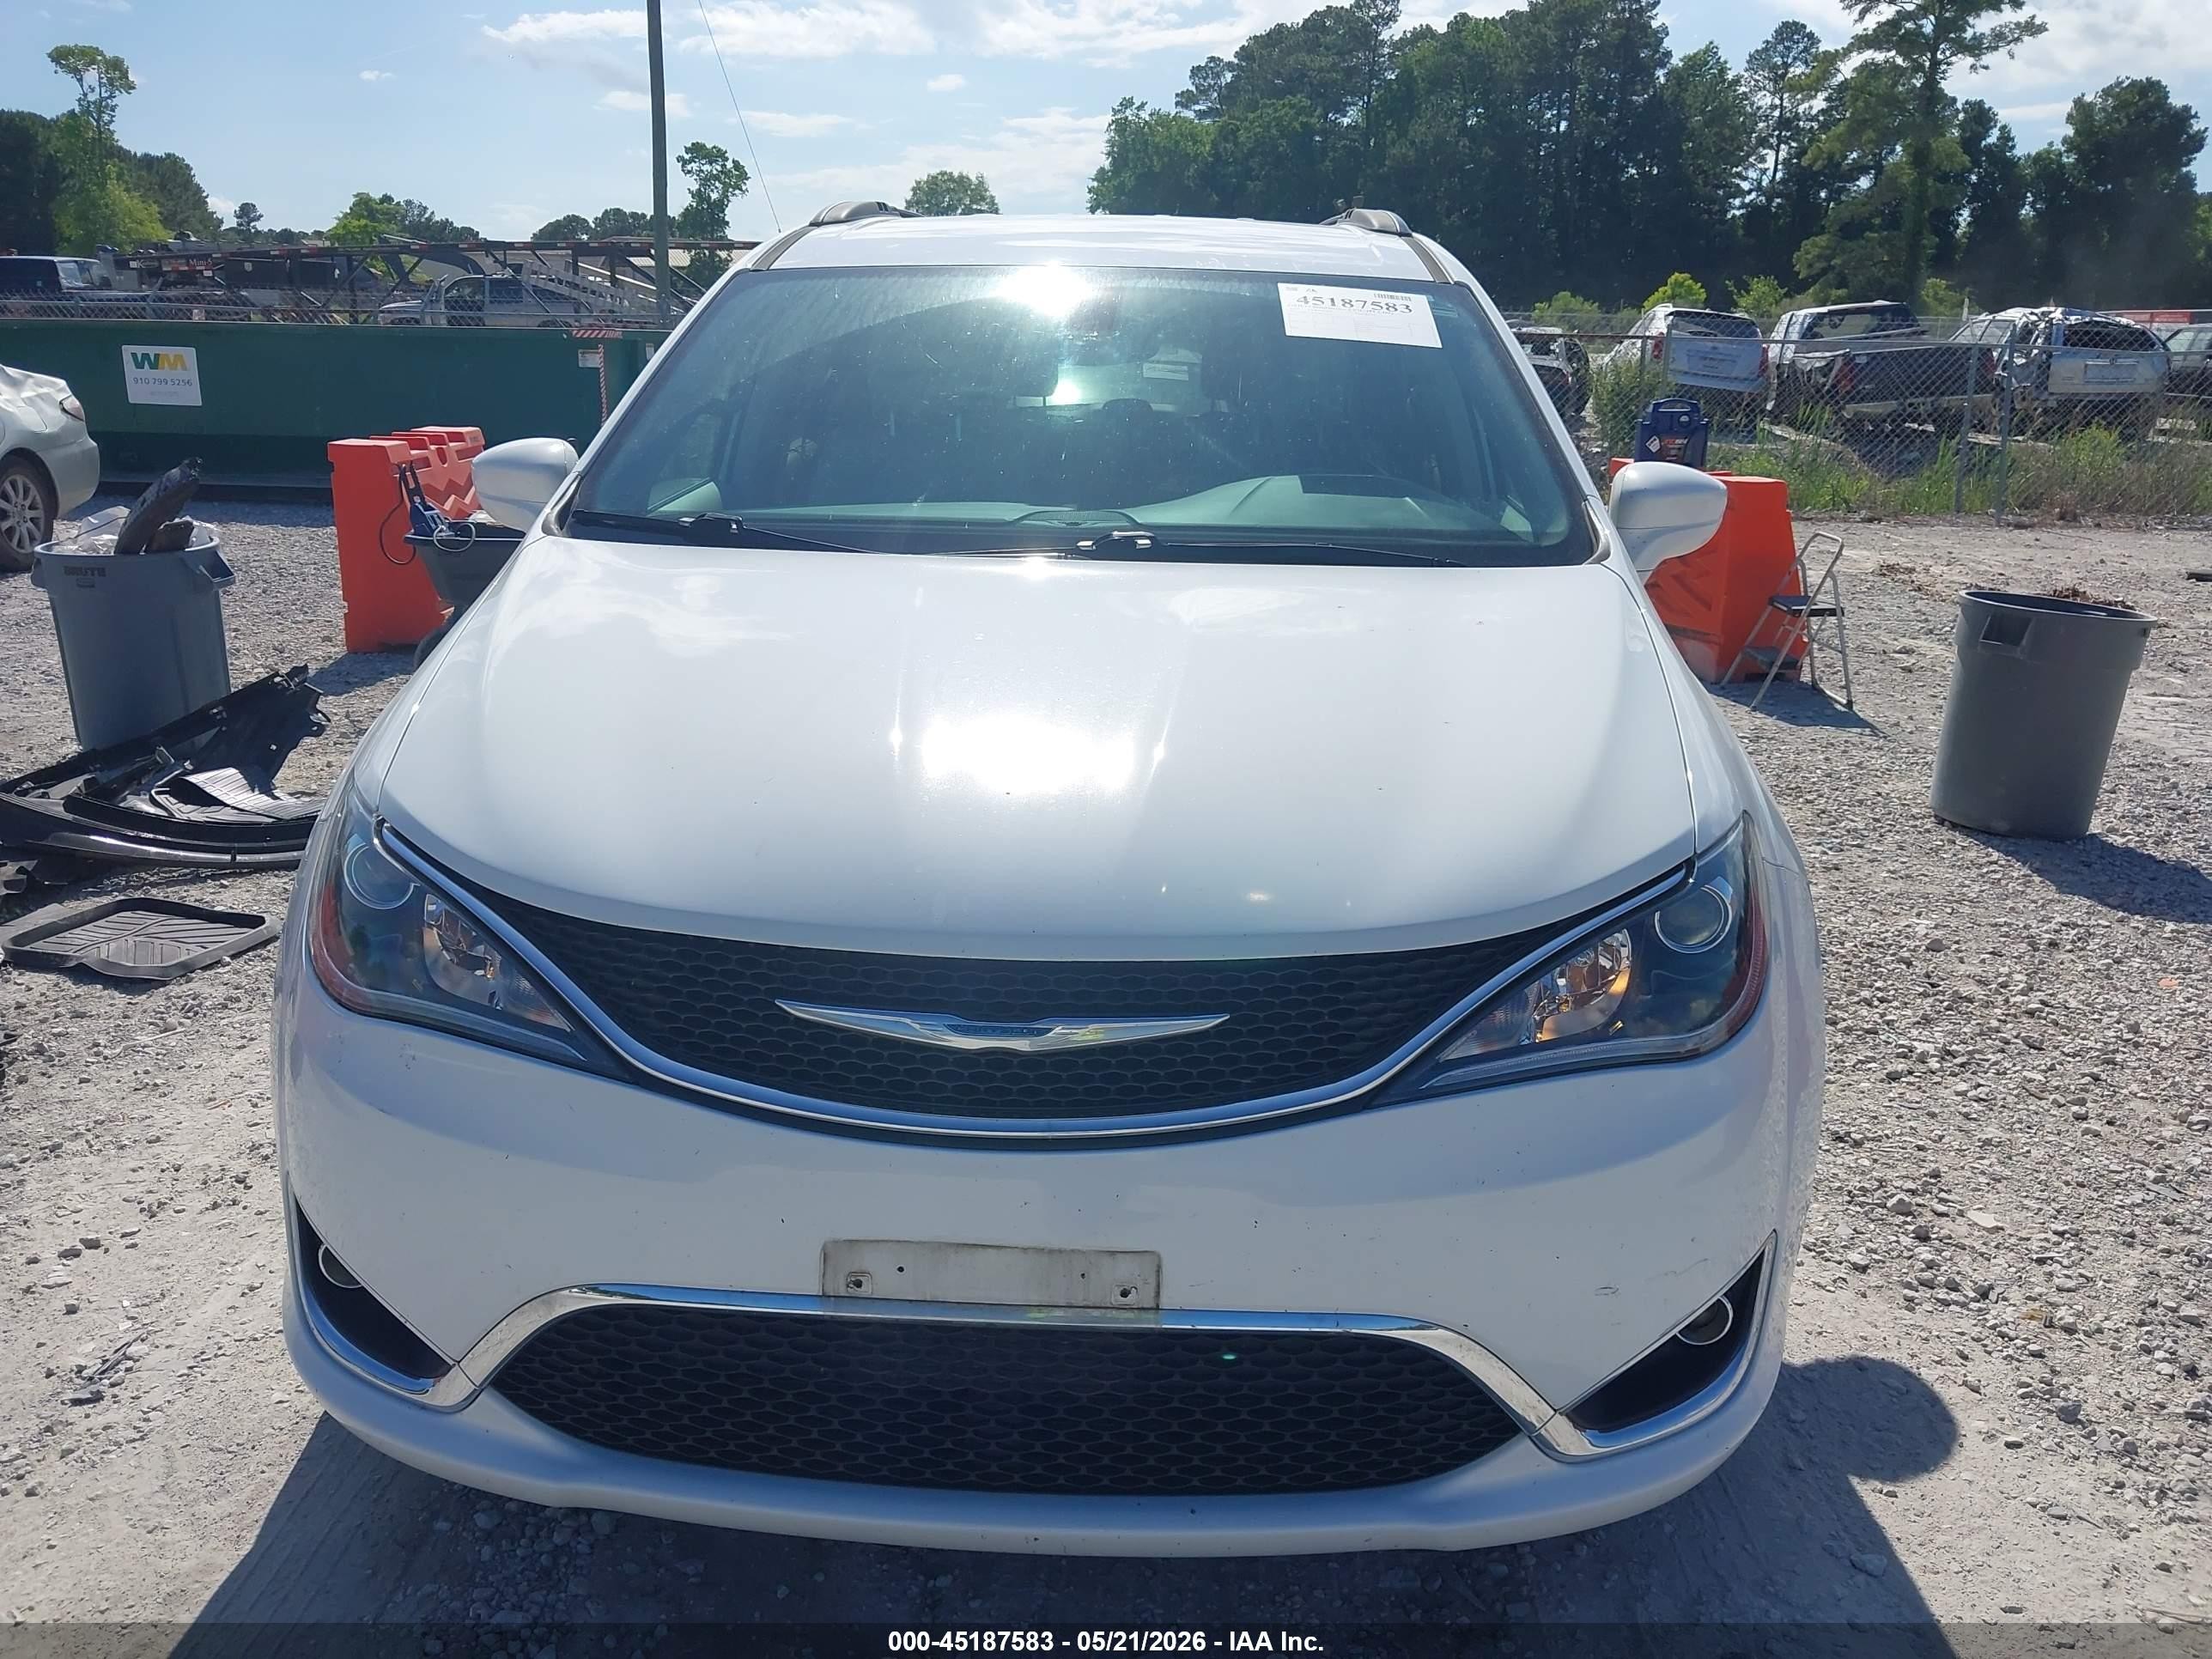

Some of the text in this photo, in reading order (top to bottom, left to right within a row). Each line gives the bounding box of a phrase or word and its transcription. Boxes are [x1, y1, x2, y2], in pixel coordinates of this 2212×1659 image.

[1295, 295, 1413, 313] 45187583
[131, 353, 187, 370] WM
[171, 378, 193, 386] 5256
